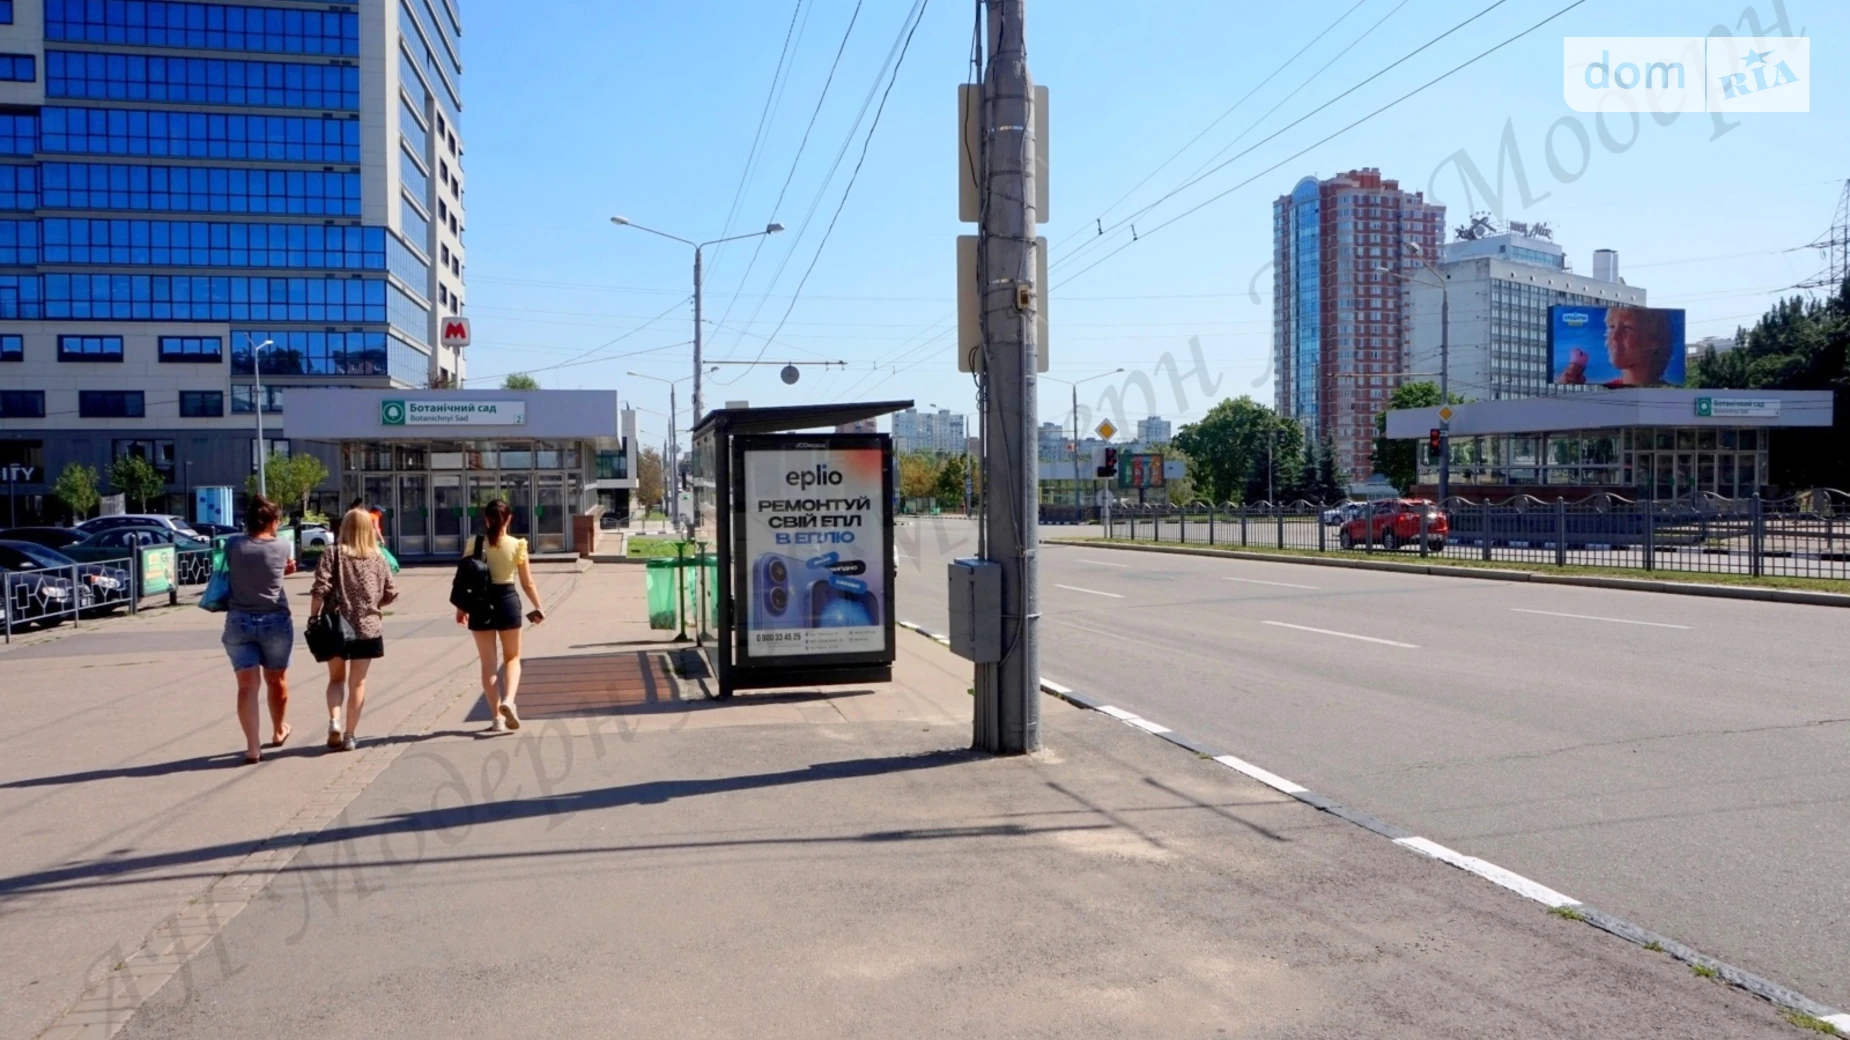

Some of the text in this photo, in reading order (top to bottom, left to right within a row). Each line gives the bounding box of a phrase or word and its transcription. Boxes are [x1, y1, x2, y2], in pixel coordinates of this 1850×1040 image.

[409, 403, 497, 414] Ботанічний сад
[410, 414, 469, 423] Botanichnyi Sad
[0, 466, 34, 480] ITY
[786, 464, 842, 491] eplio
[758, 495, 871, 512] РЕМОНТУЙ
[768, 513, 862, 529] СВІЙ ЕПЛ
[775, 533, 791, 544] В
[756, 633, 761, 642] 0
[762, 633, 774, 642] 800
[775, 633, 784, 641] 33
[784, 632, 792, 641] 45
[793, 632, 801, 641] 25
